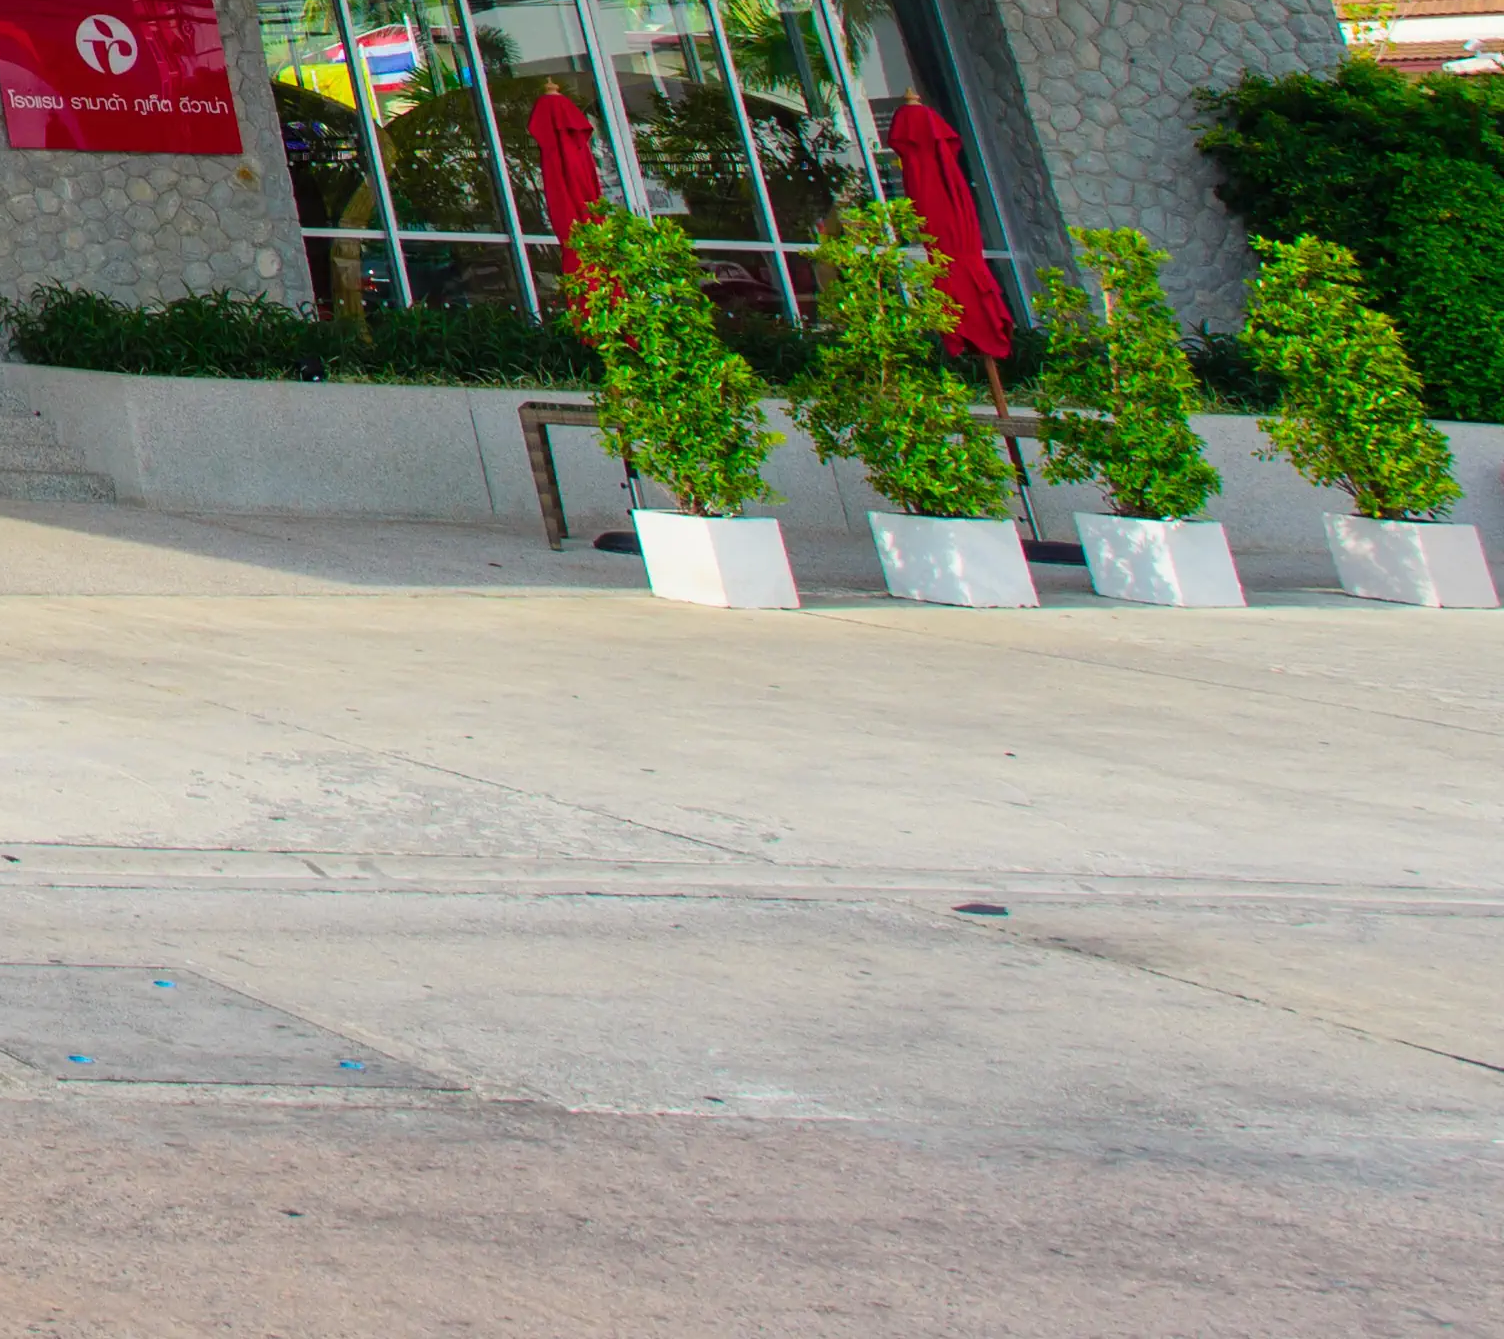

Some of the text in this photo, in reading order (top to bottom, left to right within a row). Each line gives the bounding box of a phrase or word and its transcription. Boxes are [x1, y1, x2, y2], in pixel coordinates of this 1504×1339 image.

[7, 89, 229, 116] โรงแรม รามาด้า ภูเก็ต ดีวาน่า
